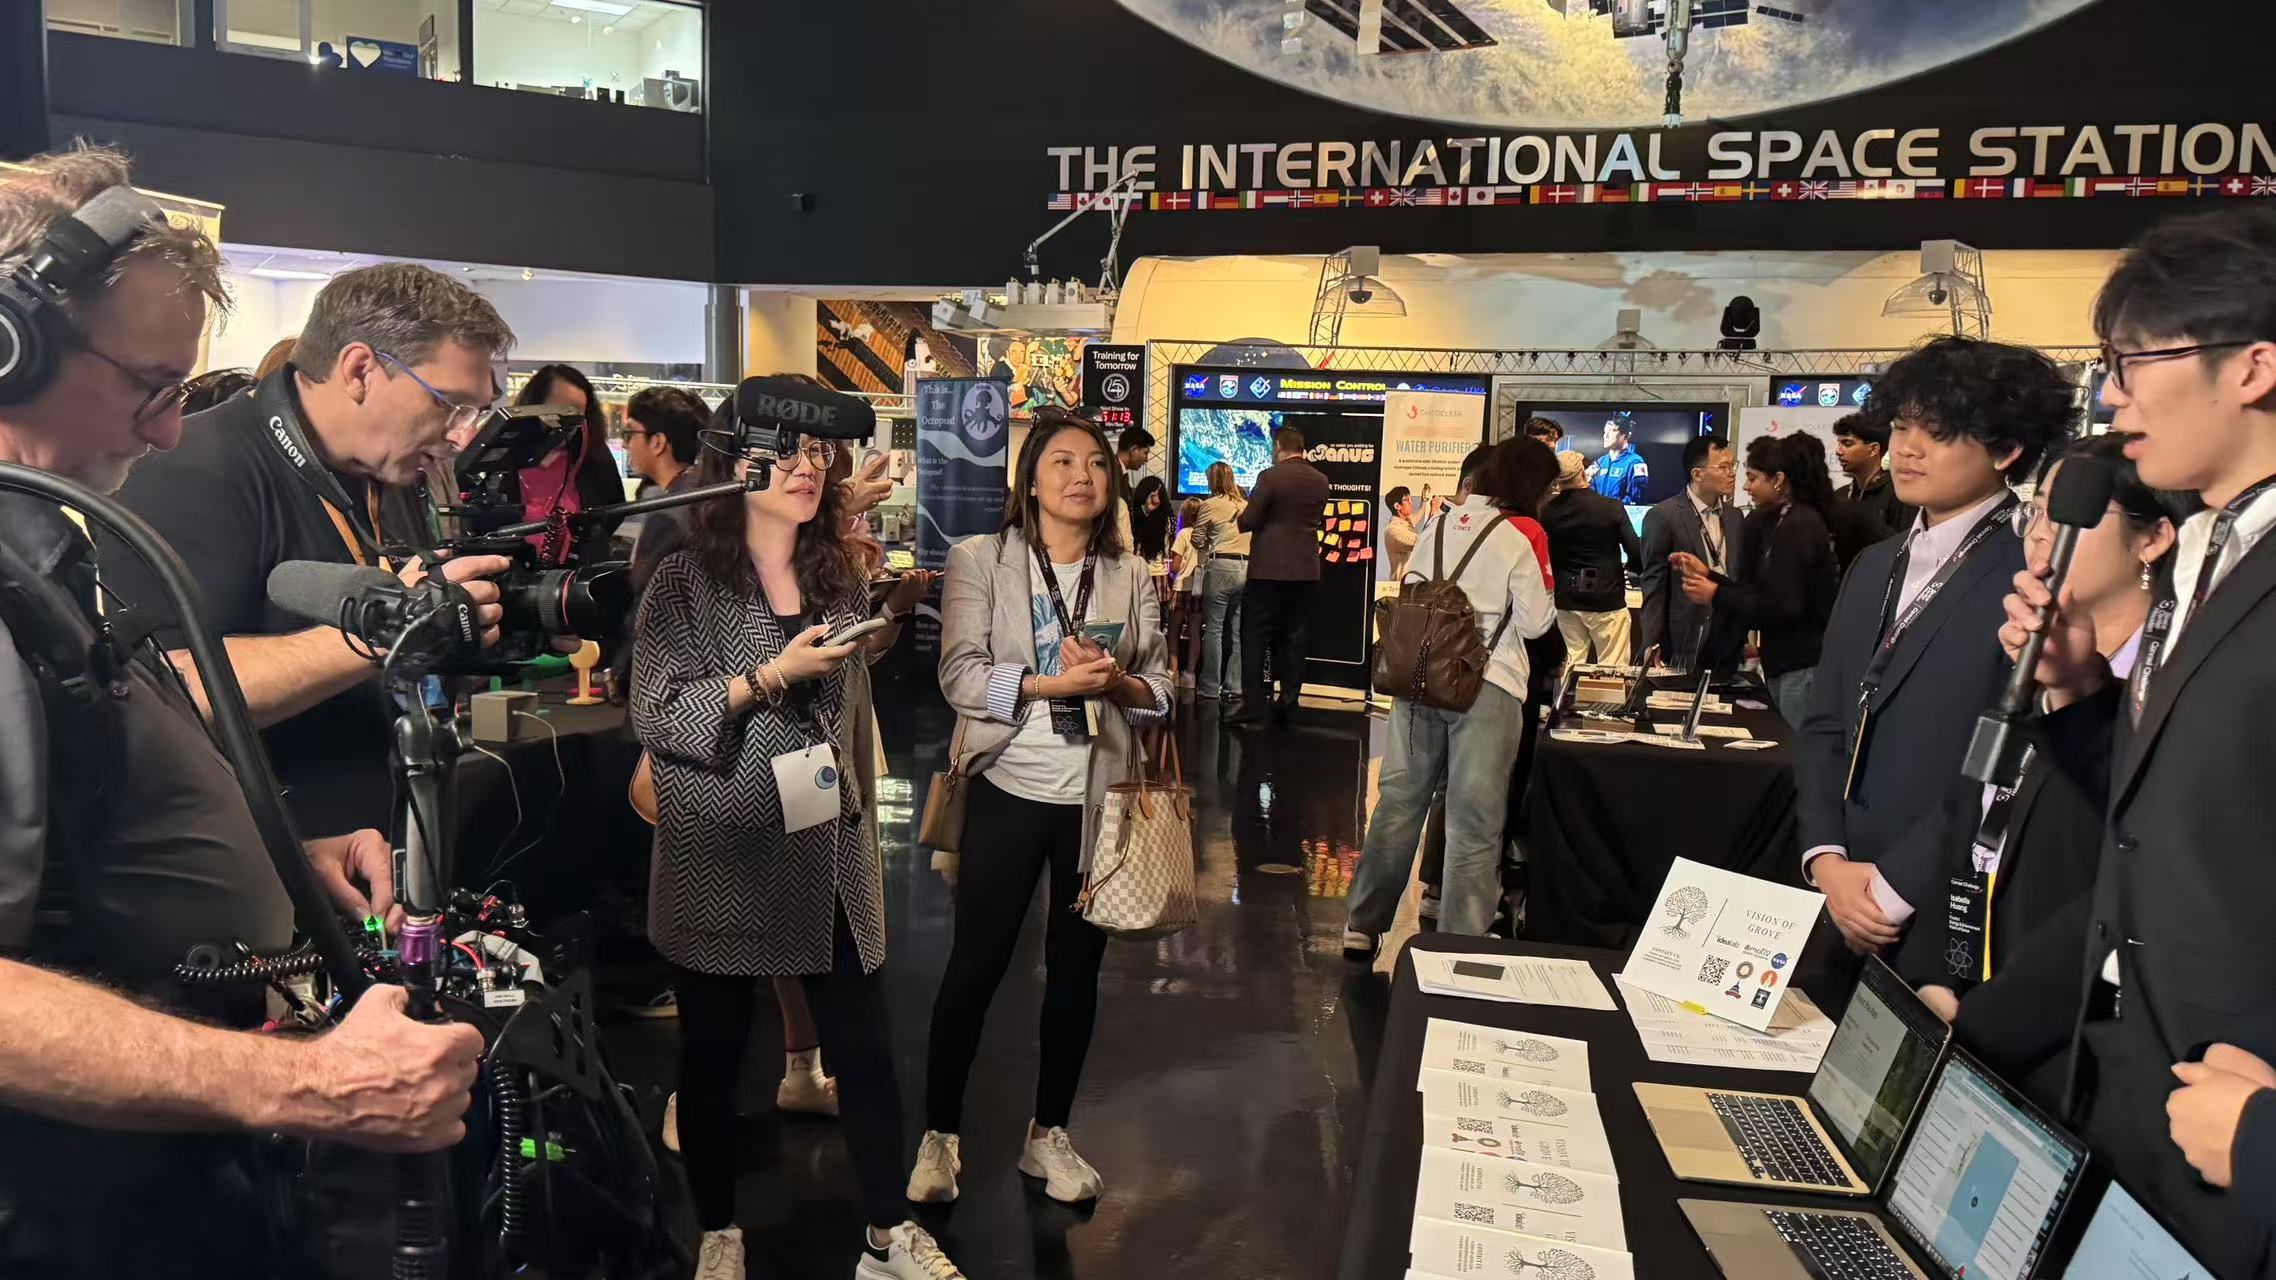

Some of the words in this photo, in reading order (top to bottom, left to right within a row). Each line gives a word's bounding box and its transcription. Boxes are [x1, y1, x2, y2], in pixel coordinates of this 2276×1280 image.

[1047, 145, 1157, 190] THE
[1182, 133, 1681, 189] INTERNATIONAL
[1707, 128, 1940, 179] SPACE
[1969, 123, 2276, 177] STATION
[1092, 351, 1126, 362] Training
[1127, 352, 1140, 360] for
[1095, 361, 1136, 370] Tomorrow
[270, 416, 306, 468] Canon
[1396, 440, 1426, 453] WATER
[458, 603, 473, 641] Canon
[2145, 641, 2160, 666] Conrad
[1746, 909, 1780, 925] VISION
[1781, 919, 1795, 929] OF
[1747, 923, 1781, 939] GROVE
